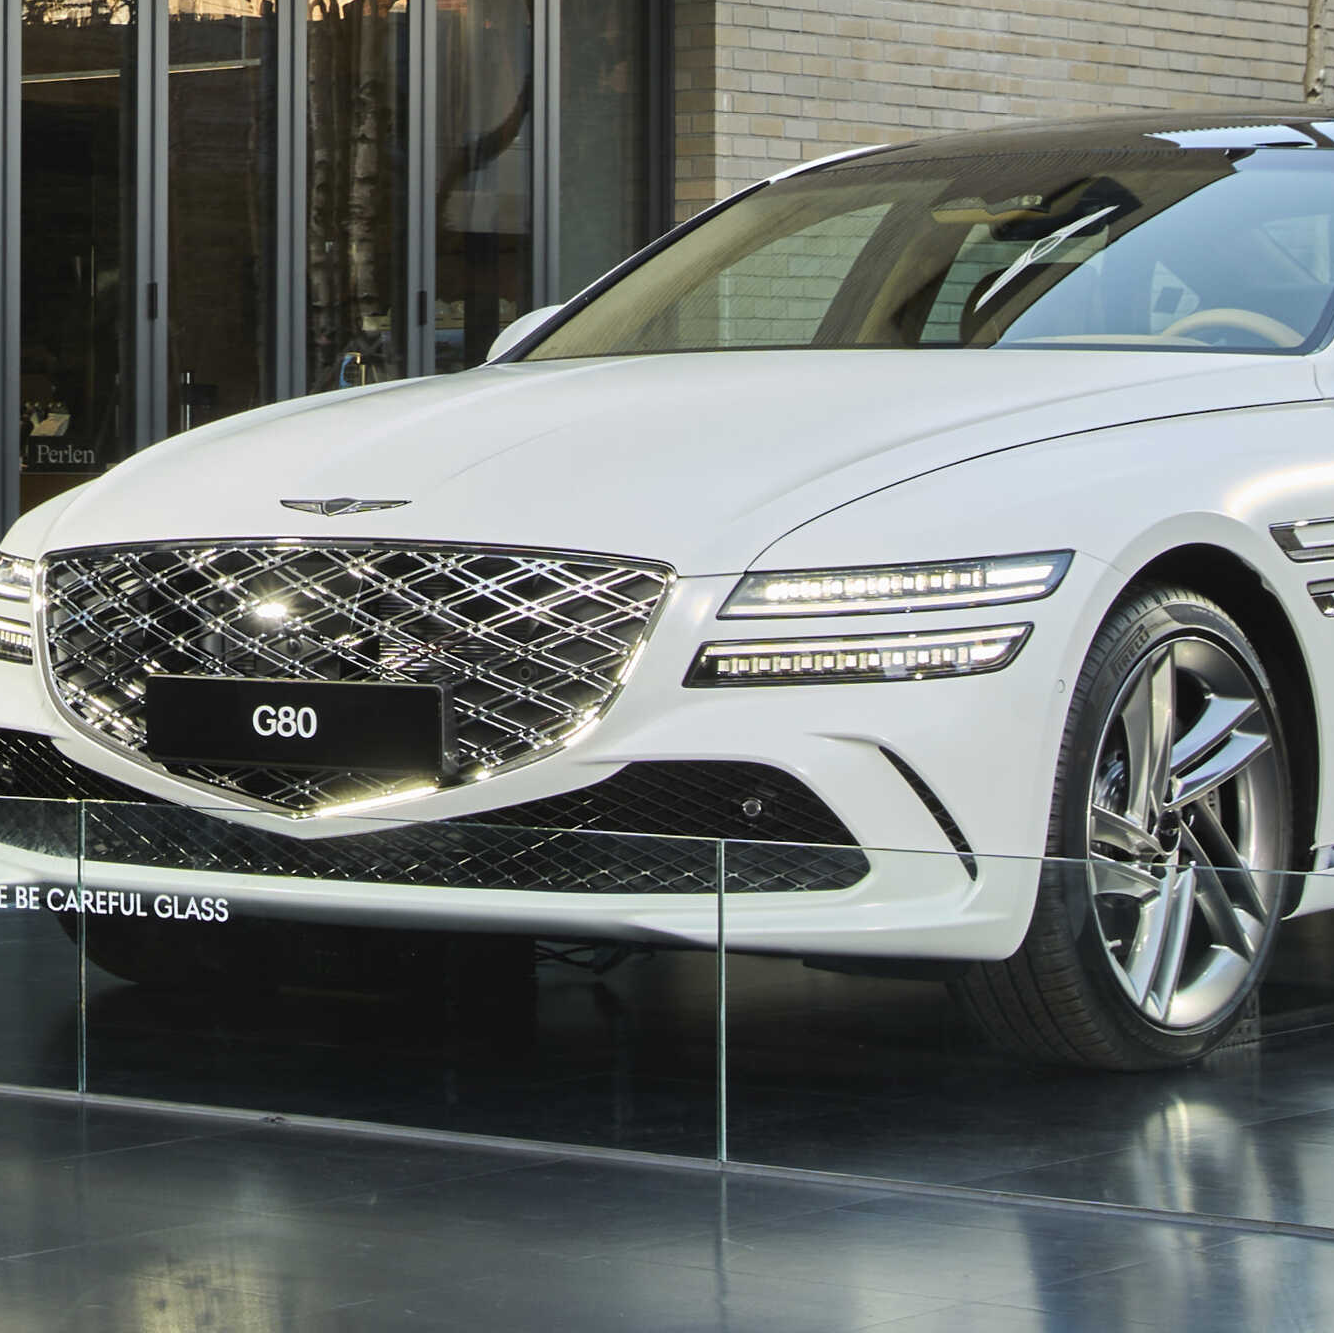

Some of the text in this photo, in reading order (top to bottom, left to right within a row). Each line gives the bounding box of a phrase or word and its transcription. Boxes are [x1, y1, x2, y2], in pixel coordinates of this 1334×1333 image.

[36, 444, 96, 464] Perlen
[1109, 623, 1152, 679] PIRELLI
[252, 704, 317, 739] G80
[15, 886, 40, 910] BE
[46, 888, 148, 917] CAREFUL
[153, 894, 229, 922] GLASS
